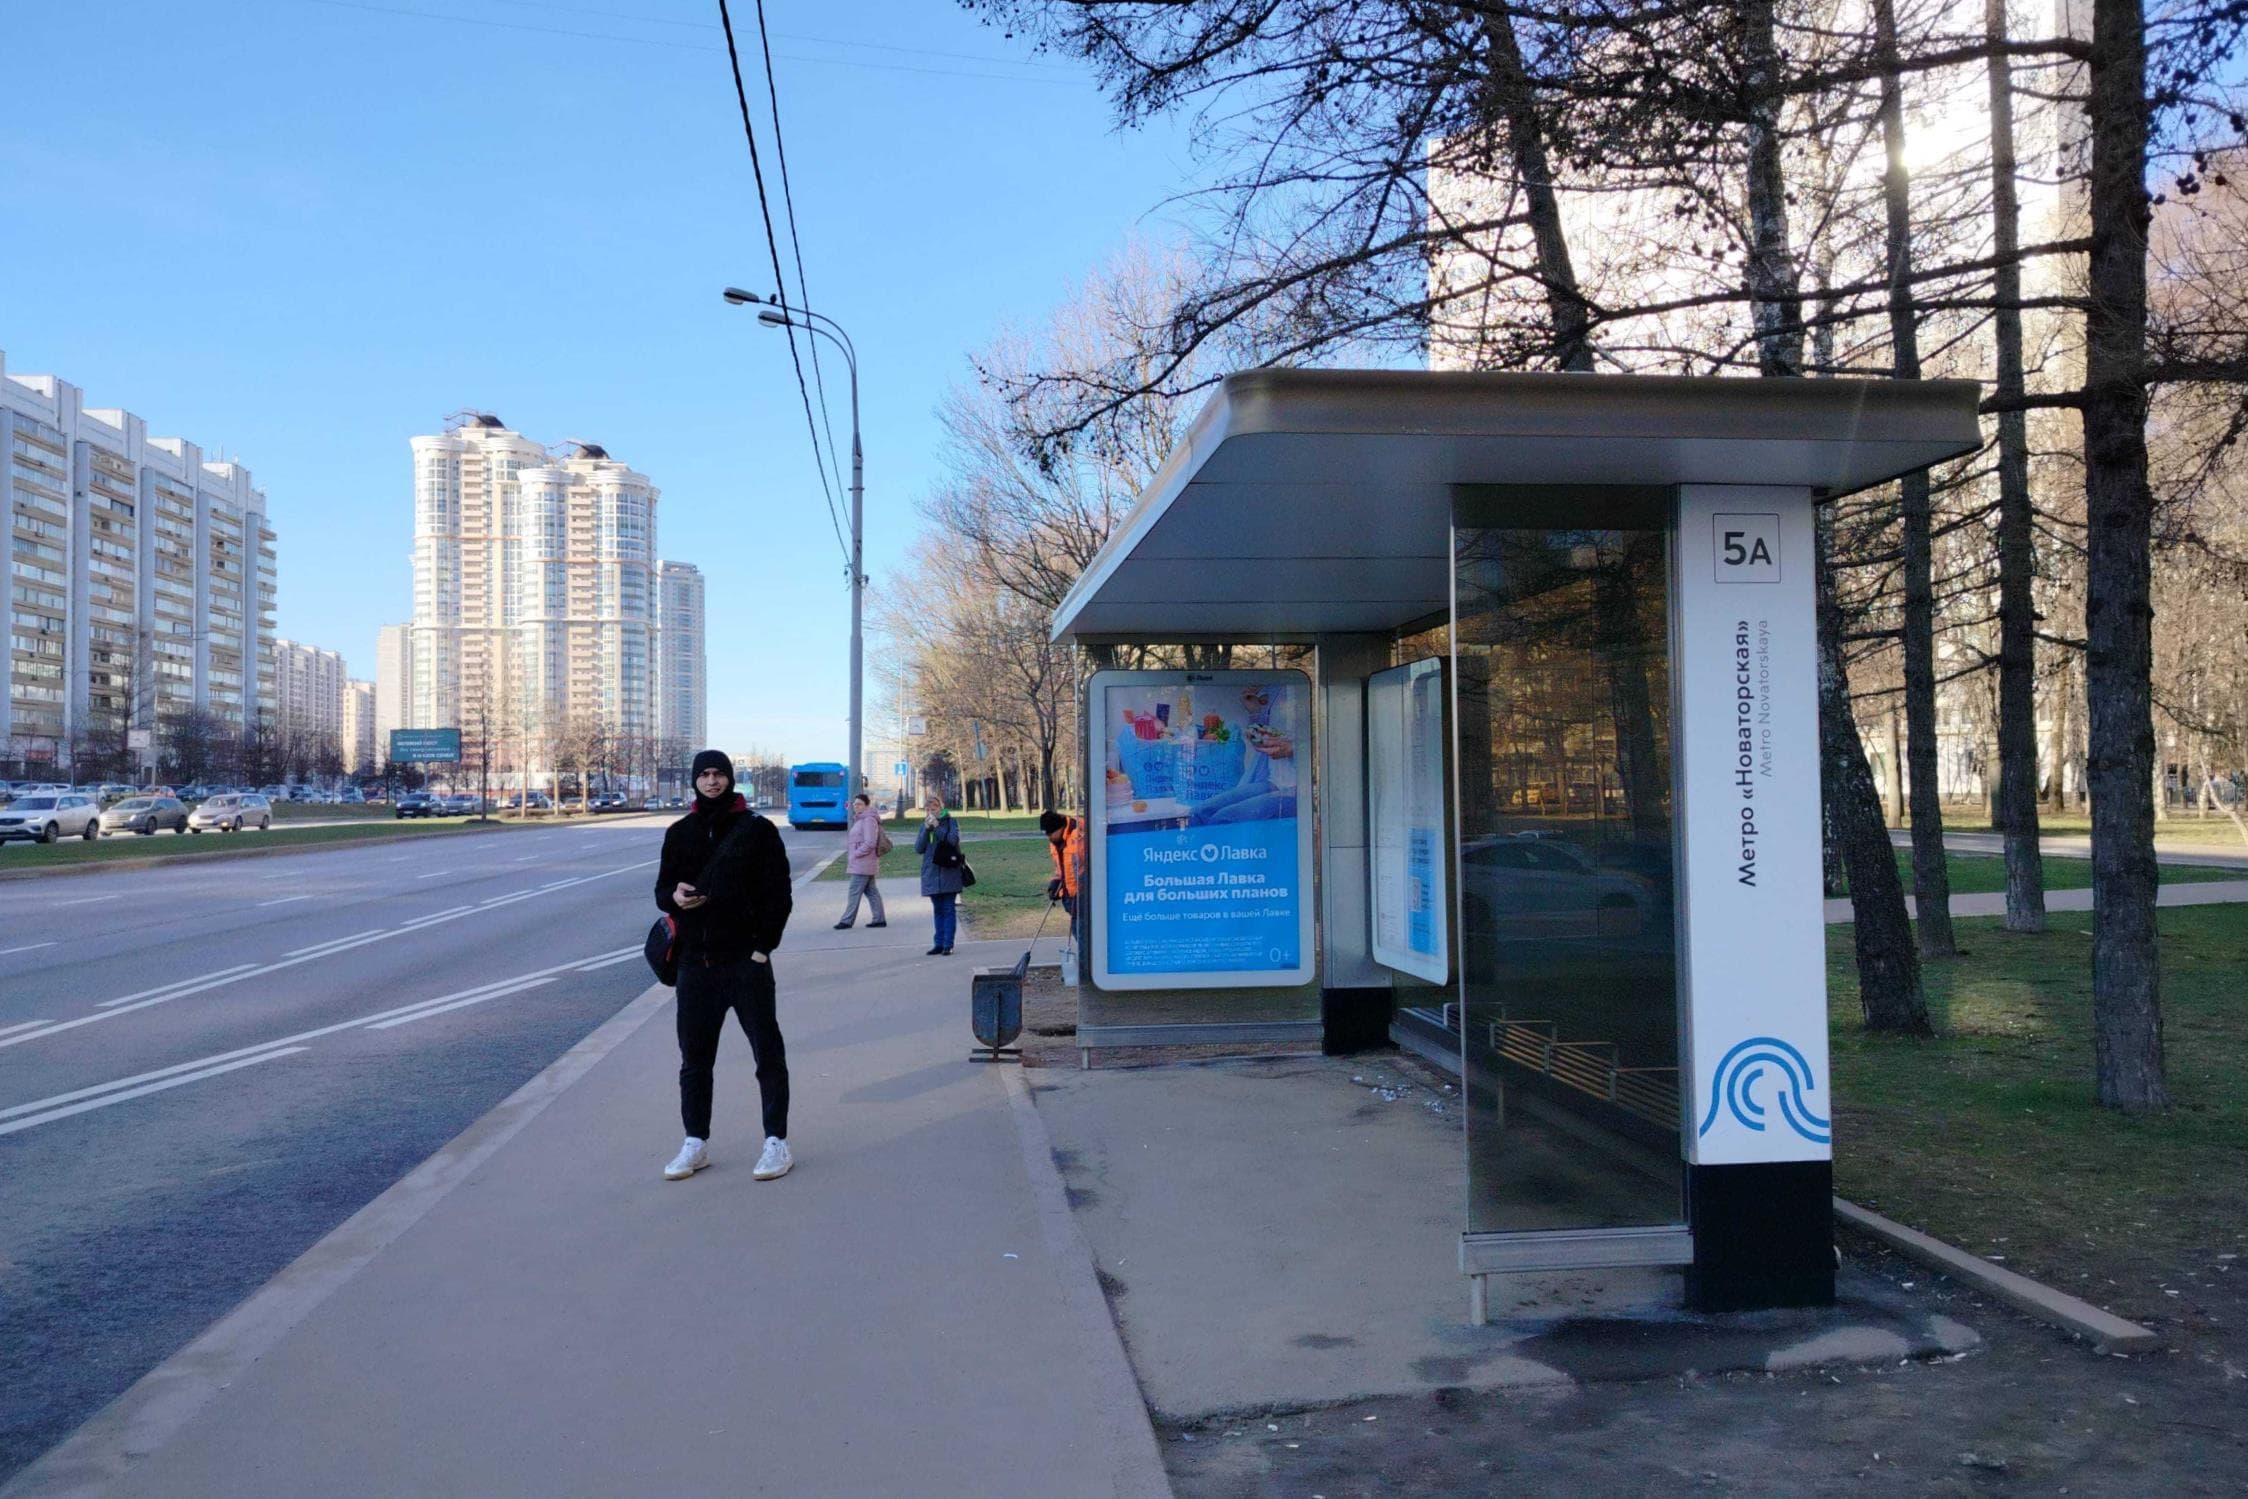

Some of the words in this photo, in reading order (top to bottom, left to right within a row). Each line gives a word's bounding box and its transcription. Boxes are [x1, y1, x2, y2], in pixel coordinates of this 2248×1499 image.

[1723, 531, 1772, 566] 5А
[1757, 619, 1771, 724] Novatorskaya
[1735, 620, 1755, 800] «Новаторская»
[1759, 728, 1773, 777] Metro
[1143, 847, 1198, 863] Яндекс
[1220, 845, 1267, 860] Лавка
[1738, 807, 1759, 887] Метро
[1144, 874, 1215, 887] Большая
[1217, 872, 1265, 885] Лавка
[1124, 890, 1154, 904] для
[1157, 888, 1228, 901] больших
[1232, 887, 1288, 899] планов
[1144, 911, 1181, 921] больше
[1183, 911, 1221, 921] товаров
[1231, 908, 1260, 919] вашей
[1262, 908, 1291, 917] Лавке
[1269, 946, 1290, 963] 0+
